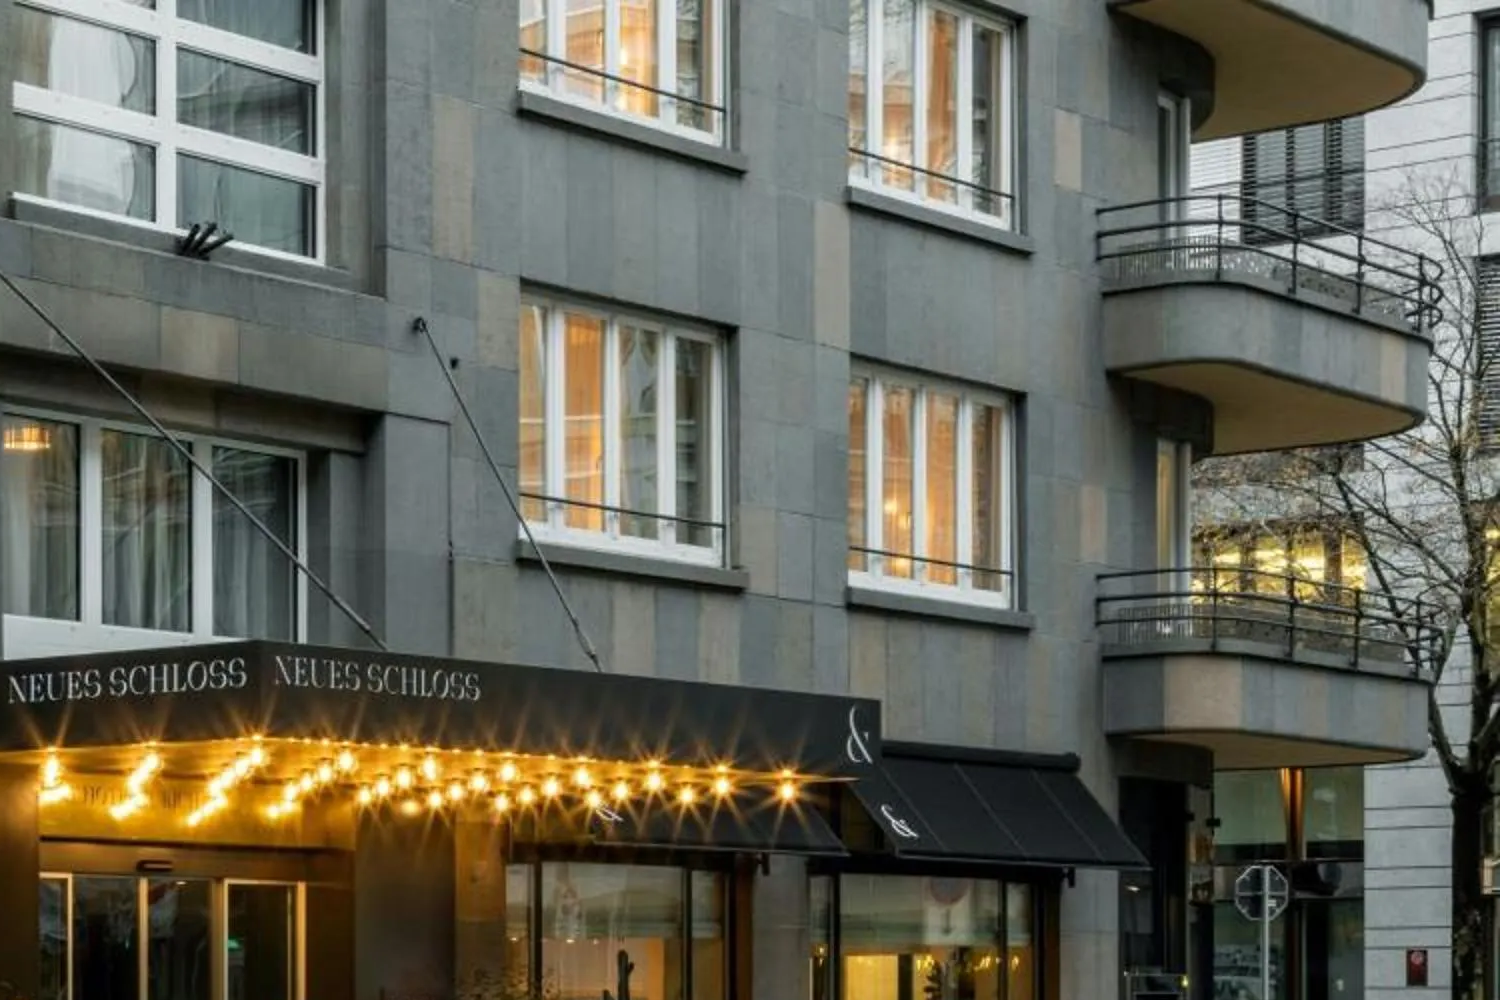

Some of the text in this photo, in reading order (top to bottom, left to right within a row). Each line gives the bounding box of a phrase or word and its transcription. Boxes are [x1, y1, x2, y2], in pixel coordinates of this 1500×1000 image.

[7, 657, 247, 704] NEUES SCHLOSS
[275, 655, 481, 701] NEUES SCHLOSS
